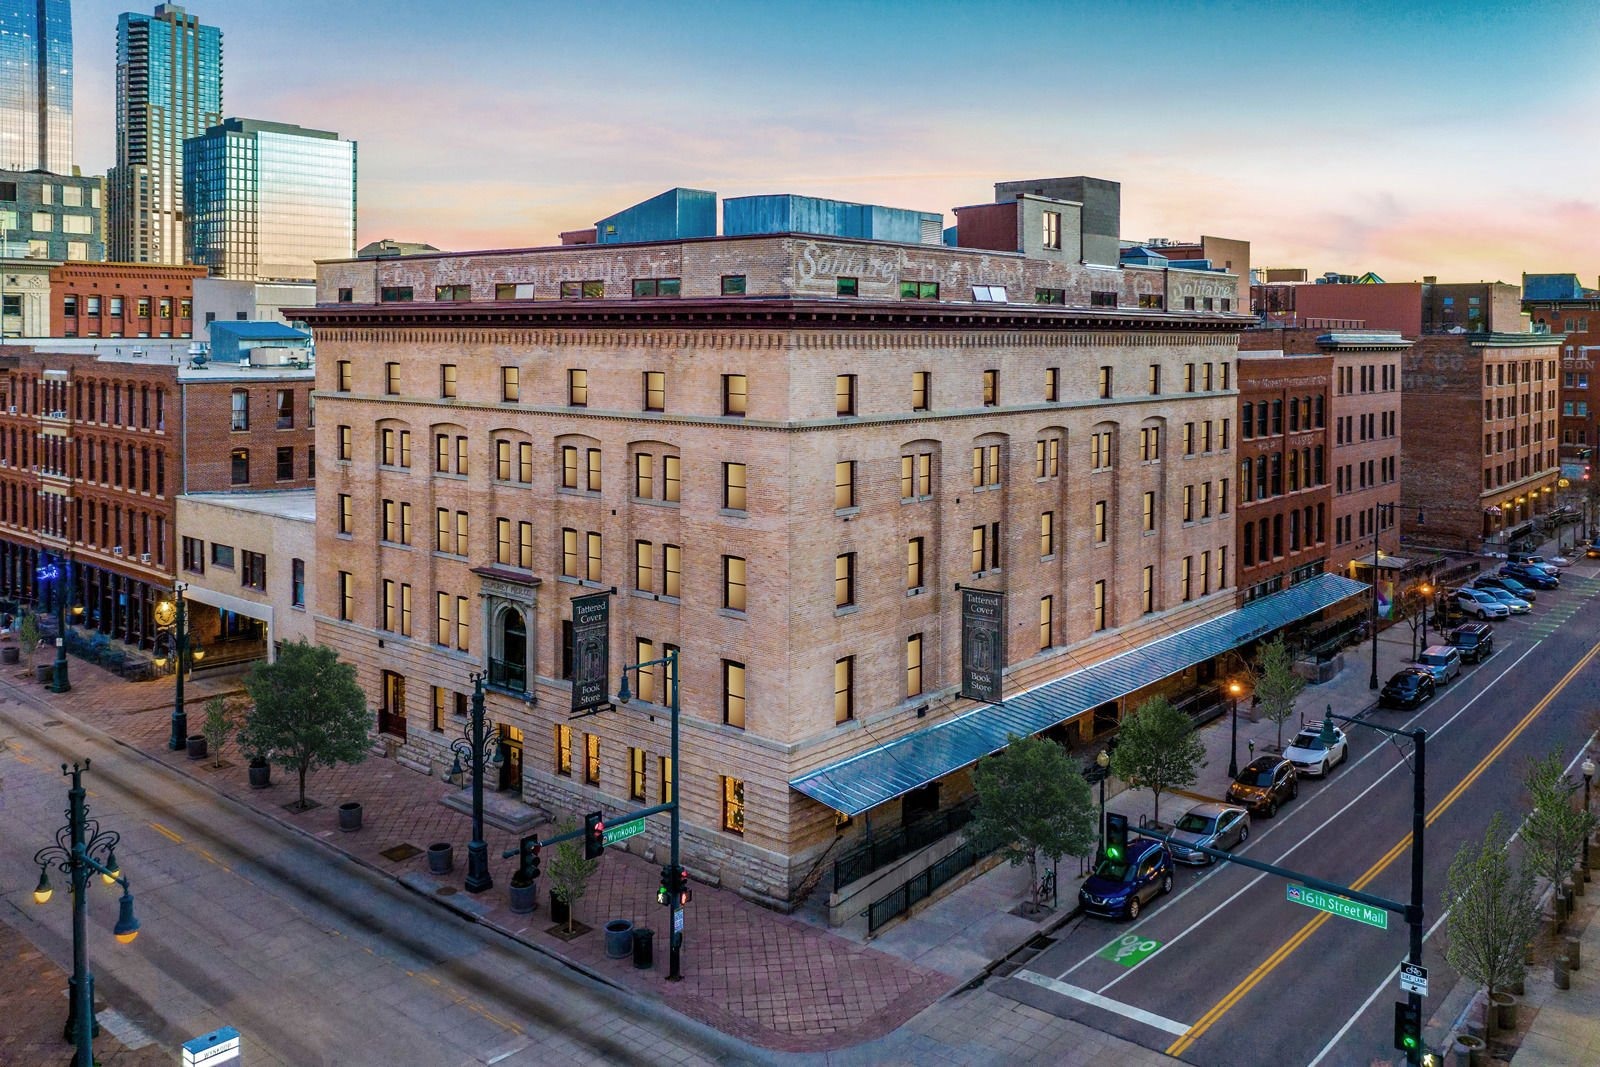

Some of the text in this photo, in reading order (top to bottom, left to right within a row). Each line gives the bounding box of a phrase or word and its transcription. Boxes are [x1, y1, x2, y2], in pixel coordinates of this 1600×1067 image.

[966, 594, 998, 606] Tattered
[576, 602, 606, 615] Tattered
[970, 604, 994, 615] Cover
[580, 614, 602, 624] Cover
[971, 672, 992, 683] Book
[582, 684, 600, 694] Book
[971, 682, 992, 693] Store
[581, 693, 600, 705] Store
[608, 825, 637, 841] Wynkoop
[1301, 890, 1384, 924] 16th Street Mall
